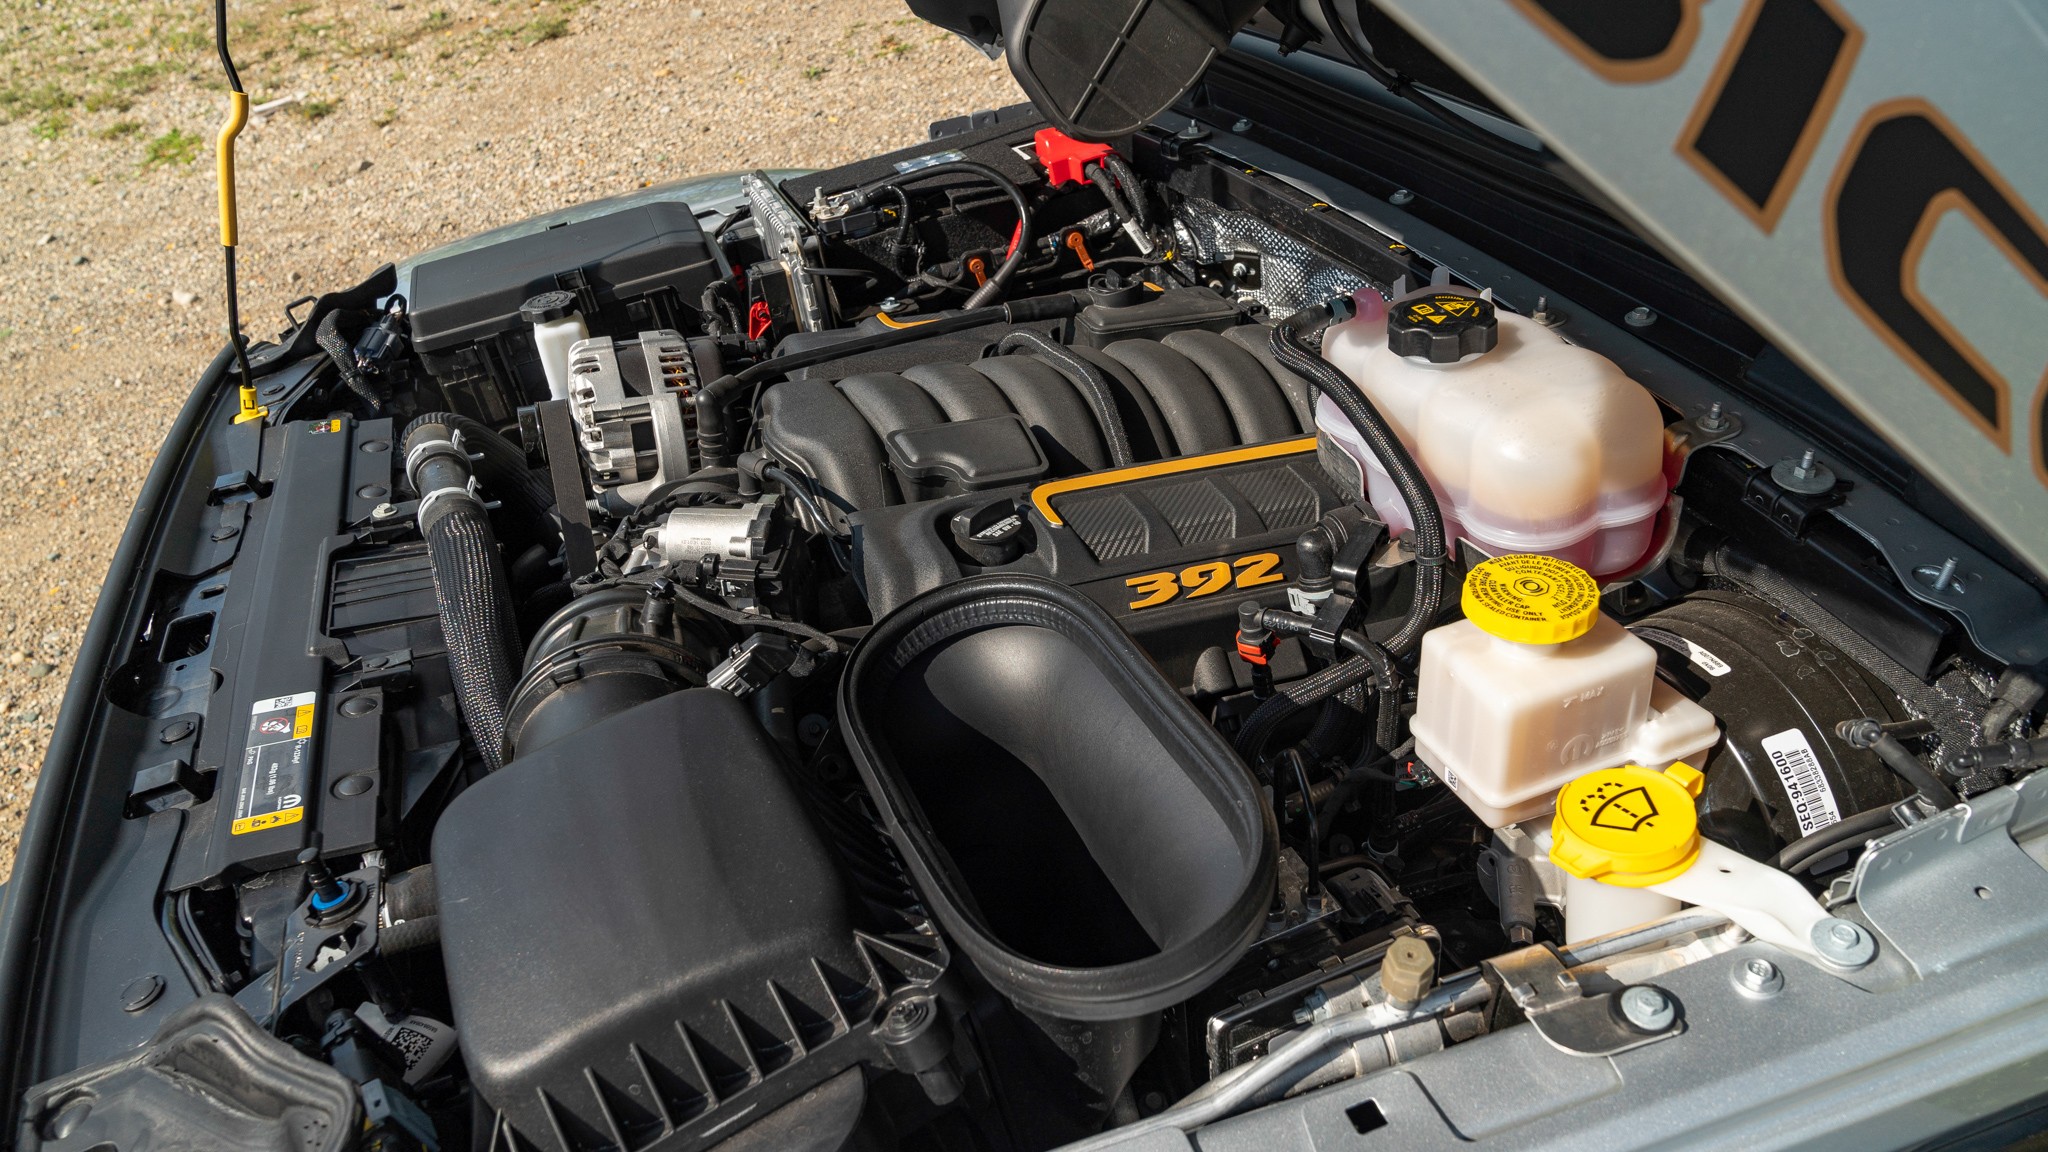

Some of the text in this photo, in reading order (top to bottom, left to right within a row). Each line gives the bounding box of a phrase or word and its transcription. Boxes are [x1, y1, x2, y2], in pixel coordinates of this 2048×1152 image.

[1125, 552, 1284, 610] 392
[1514, 602, 1531, 610] CAP
[1771, 750, 1814, 832] SEQ:941600
